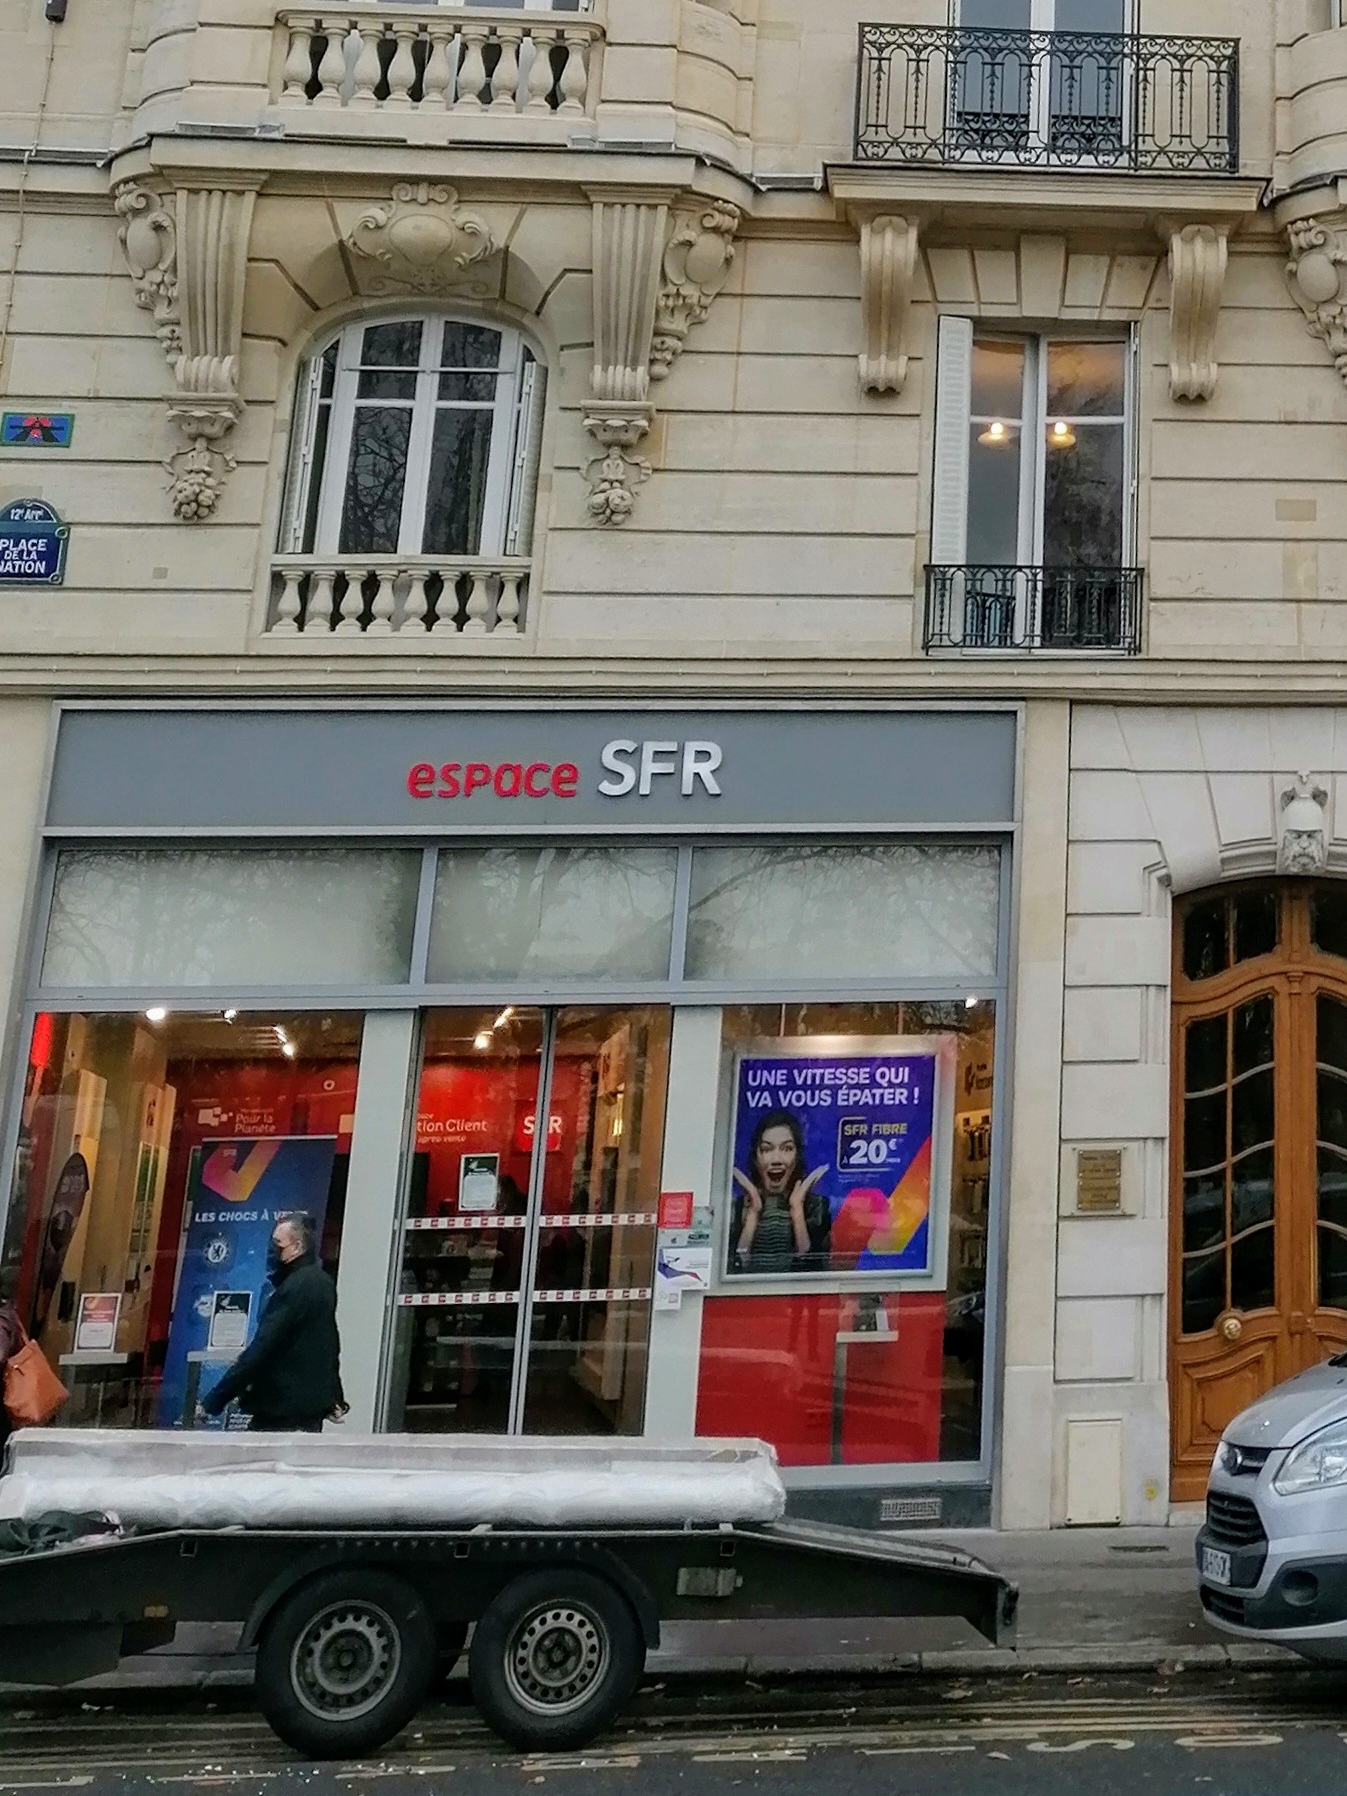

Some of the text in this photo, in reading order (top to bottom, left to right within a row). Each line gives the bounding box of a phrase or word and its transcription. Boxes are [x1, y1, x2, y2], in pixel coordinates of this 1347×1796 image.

[0, 538, 48, 551] PLACE
[4, 550, 38, 560] DE LA
[406, 739, 723, 798] espace SFR
[747, 1066, 909, 1086] UNE VITESSE QUI
[746, 1085, 919, 1108] VA VOUS ÉPATER !
[445, 1118, 489, 1132] Client
[523, 1115, 563, 1134] SR
[844, 1122, 908, 1136] SFR FIBRE
[195, 1211, 216, 1223] LES
[219, 1210, 257, 1222] CHOCS
[261, 1208, 269, 1221] À
